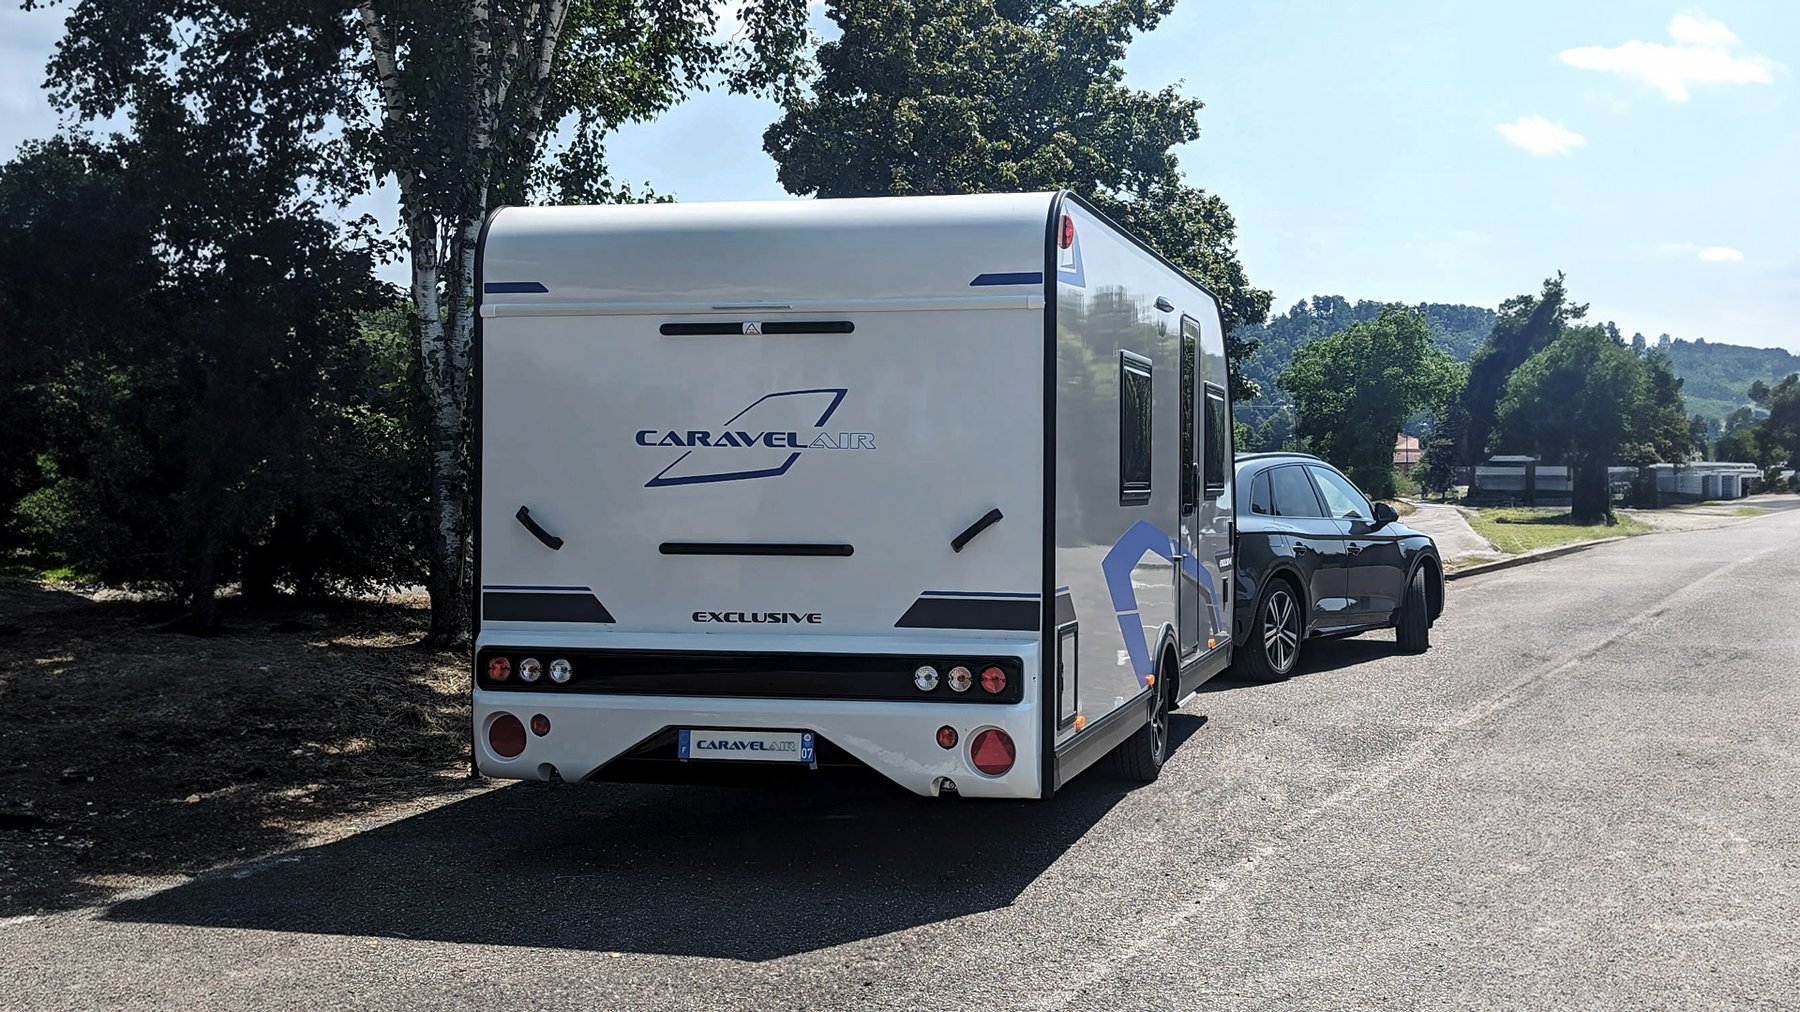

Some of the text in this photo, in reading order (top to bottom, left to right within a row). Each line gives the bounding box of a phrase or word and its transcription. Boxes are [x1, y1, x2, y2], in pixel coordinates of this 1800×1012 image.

[635, 430, 877, 450] CARAVELAIR
[692, 611, 822, 624] EXCLUSIVE
[696, 740, 796, 752] CARAVELAIR
[801, 748, 813, 758] 07
